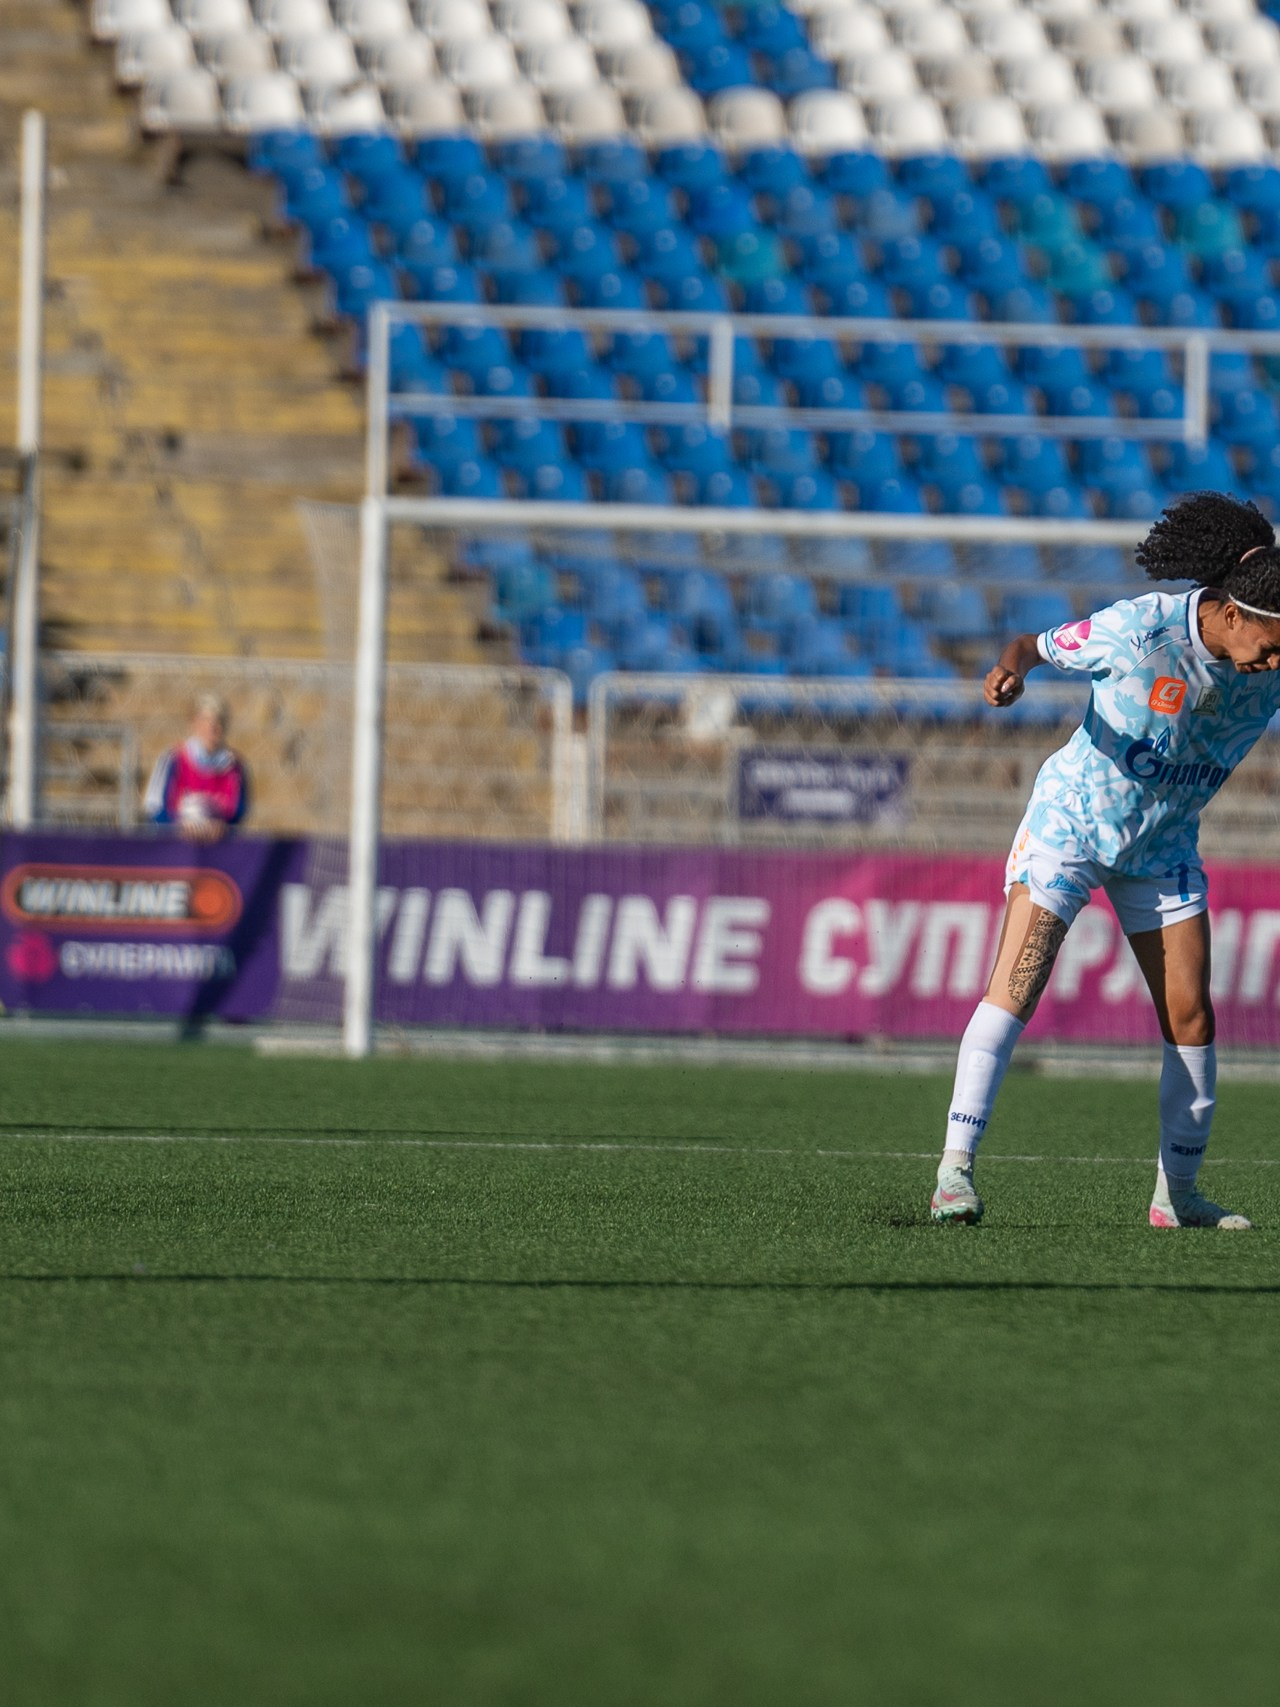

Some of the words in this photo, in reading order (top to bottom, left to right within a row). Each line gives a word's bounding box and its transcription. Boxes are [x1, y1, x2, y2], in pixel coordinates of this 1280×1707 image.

[20, 877, 191, 919] WINLINE
[279, 883, 770, 992] WINLINE
[950, 1111, 988, 1131] ЗЕНИТ
